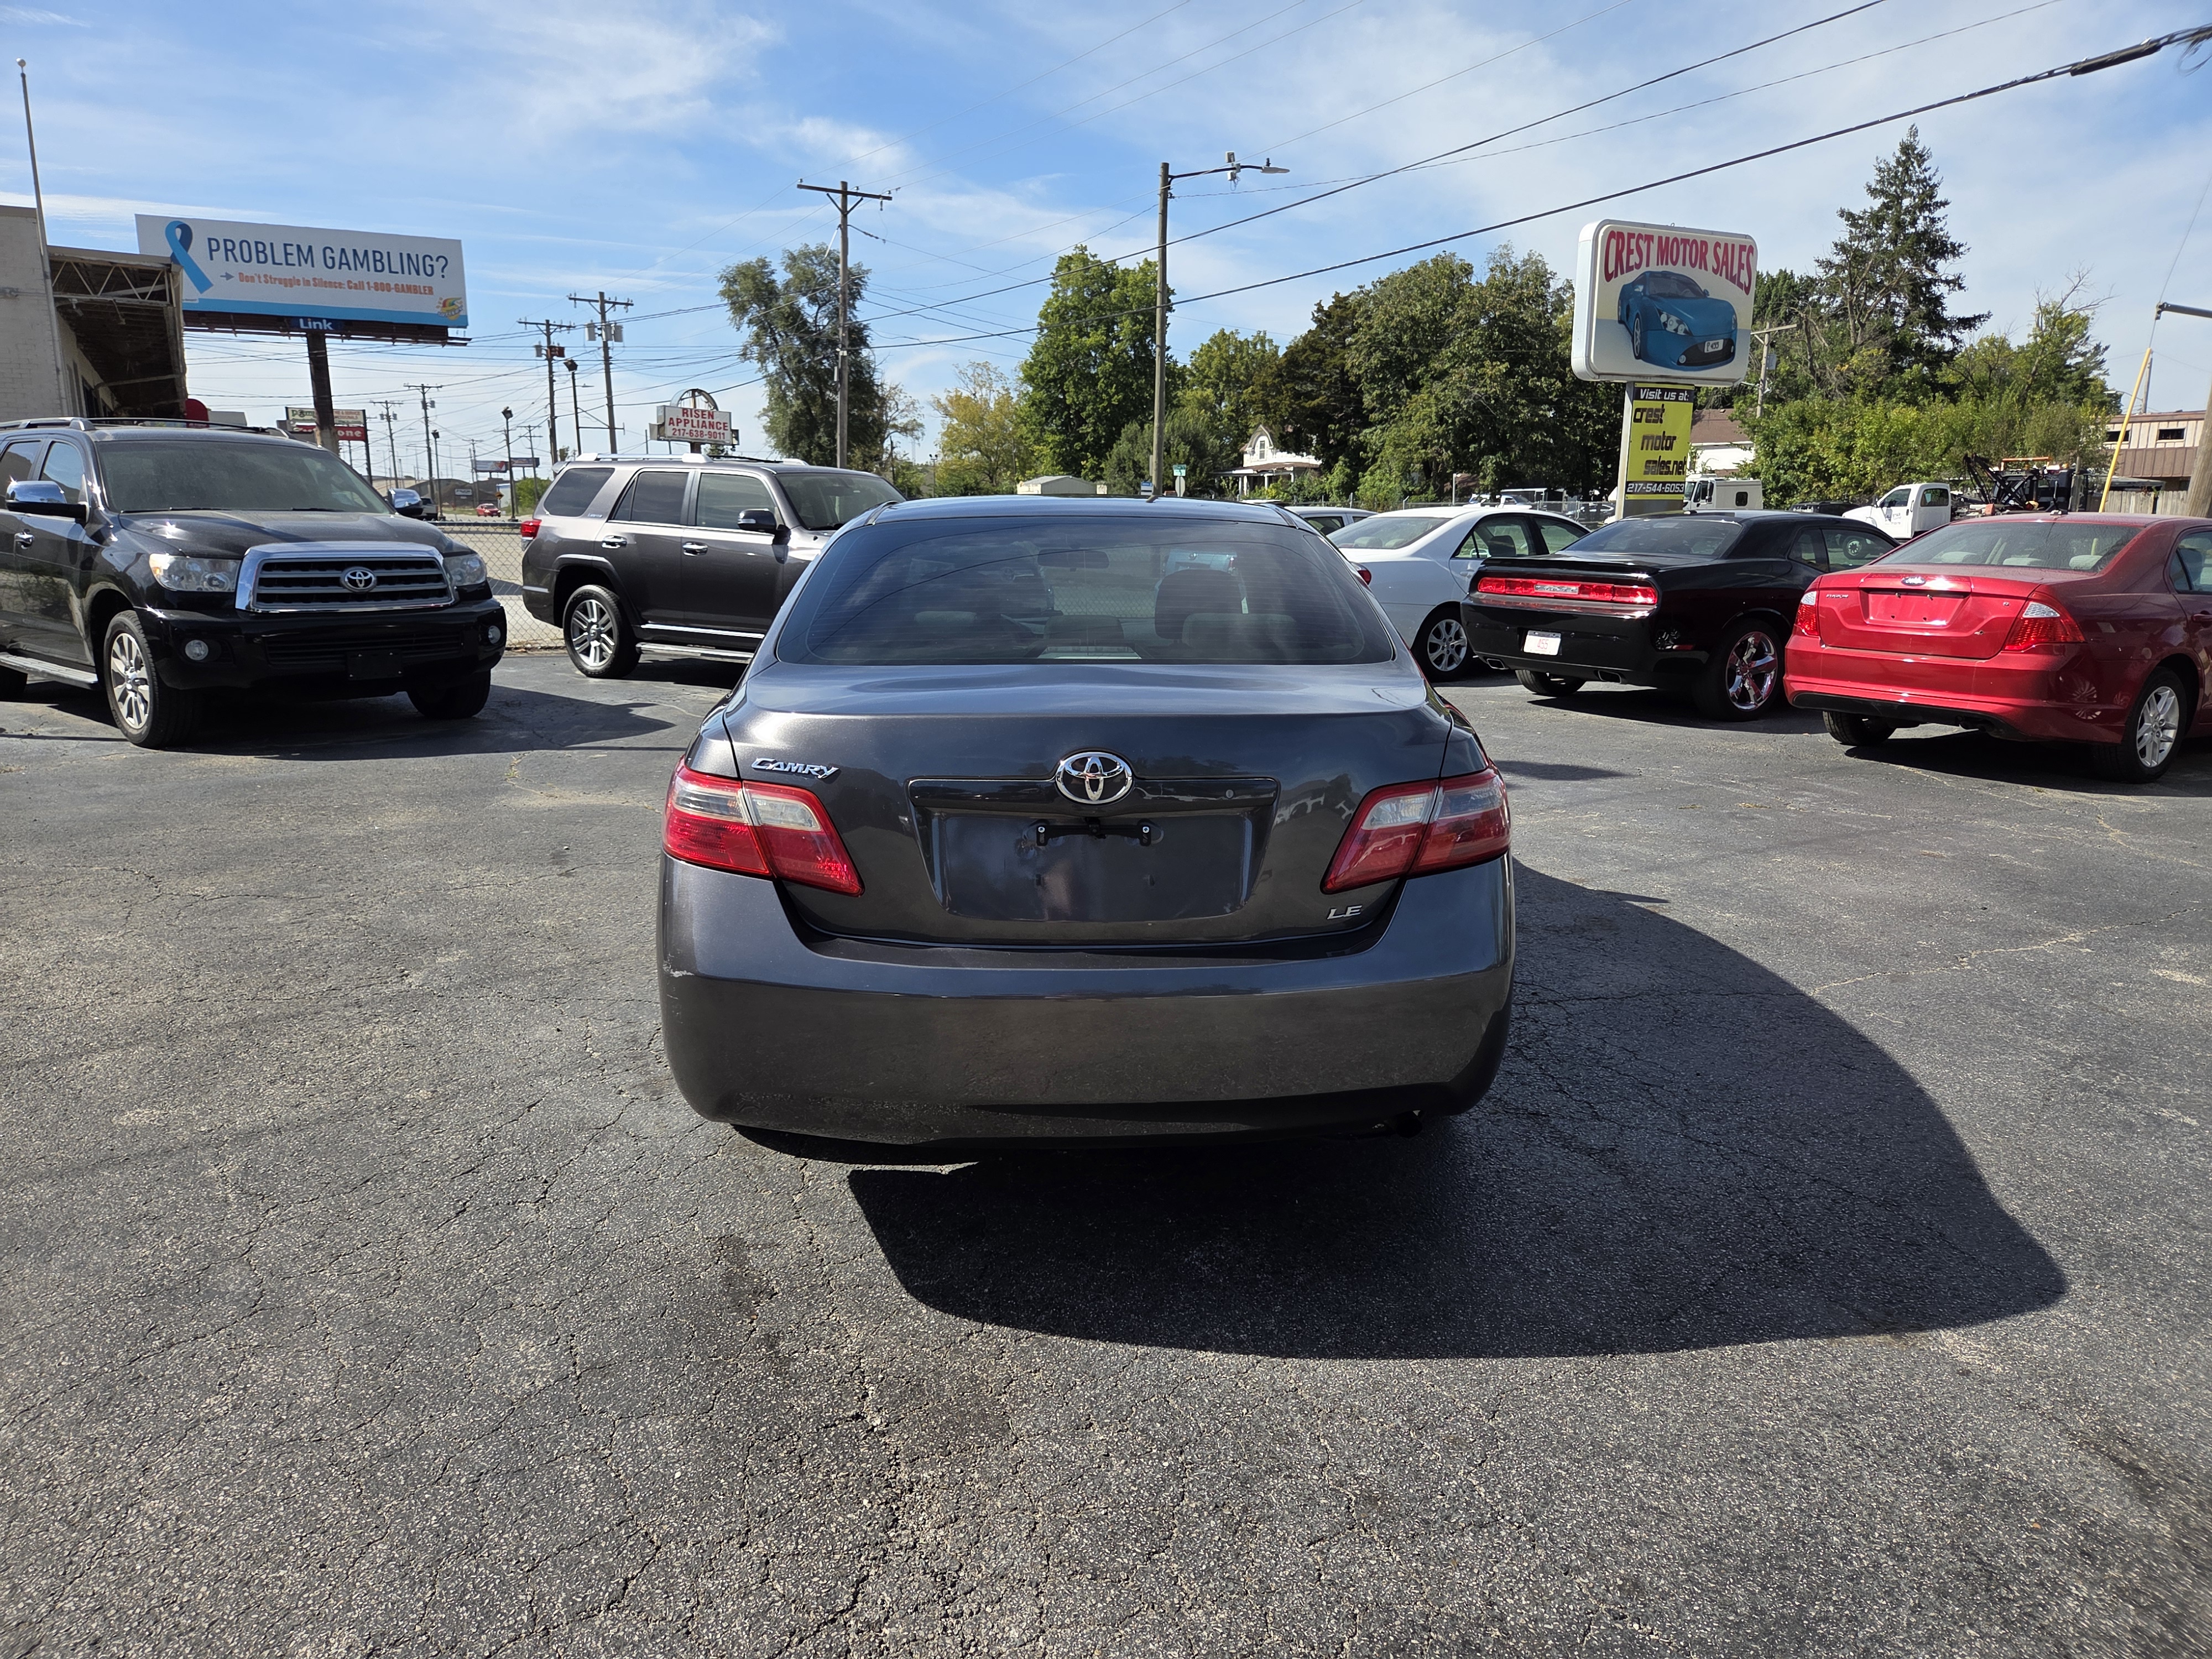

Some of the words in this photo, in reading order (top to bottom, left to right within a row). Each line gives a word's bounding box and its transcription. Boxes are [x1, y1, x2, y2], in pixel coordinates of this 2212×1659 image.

[207, 237, 315, 268] PROBLEM
[322, 246, 448, 279] GAMBLING?
[1604, 230, 1654, 283] CREST
[1656, 236, 1708, 272] MOTOR
[1712, 241, 1754, 296] SALES
[238, 272, 262, 284] Don't
[263, 274, 301, 288] Struggle
[347, 279, 364, 291] Call
[366, 281, 434, 295] 1-800-GAMBLER
[299, 318, 334, 330] Link
[1640, 388, 1662, 400] Visit
[1663, 391, 1677, 400] us
[1678, 390, 1689, 401] at:
[682, 408, 714, 420] RISEN
[1633, 403, 1666, 424] crest
[668, 417, 729, 431] APPLIANCE
[672, 427, 726, 440] 217-638-9011
[1640, 430, 1677, 451] motor
[1643, 455, 1687, 476] sales.net
[1626, 483, 1685, 493] 217-544-6053
[1537, 638, 1550, 650] 455
[751, 757, 839, 779] CAMRY
[1327, 905, 1363, 920] LE
